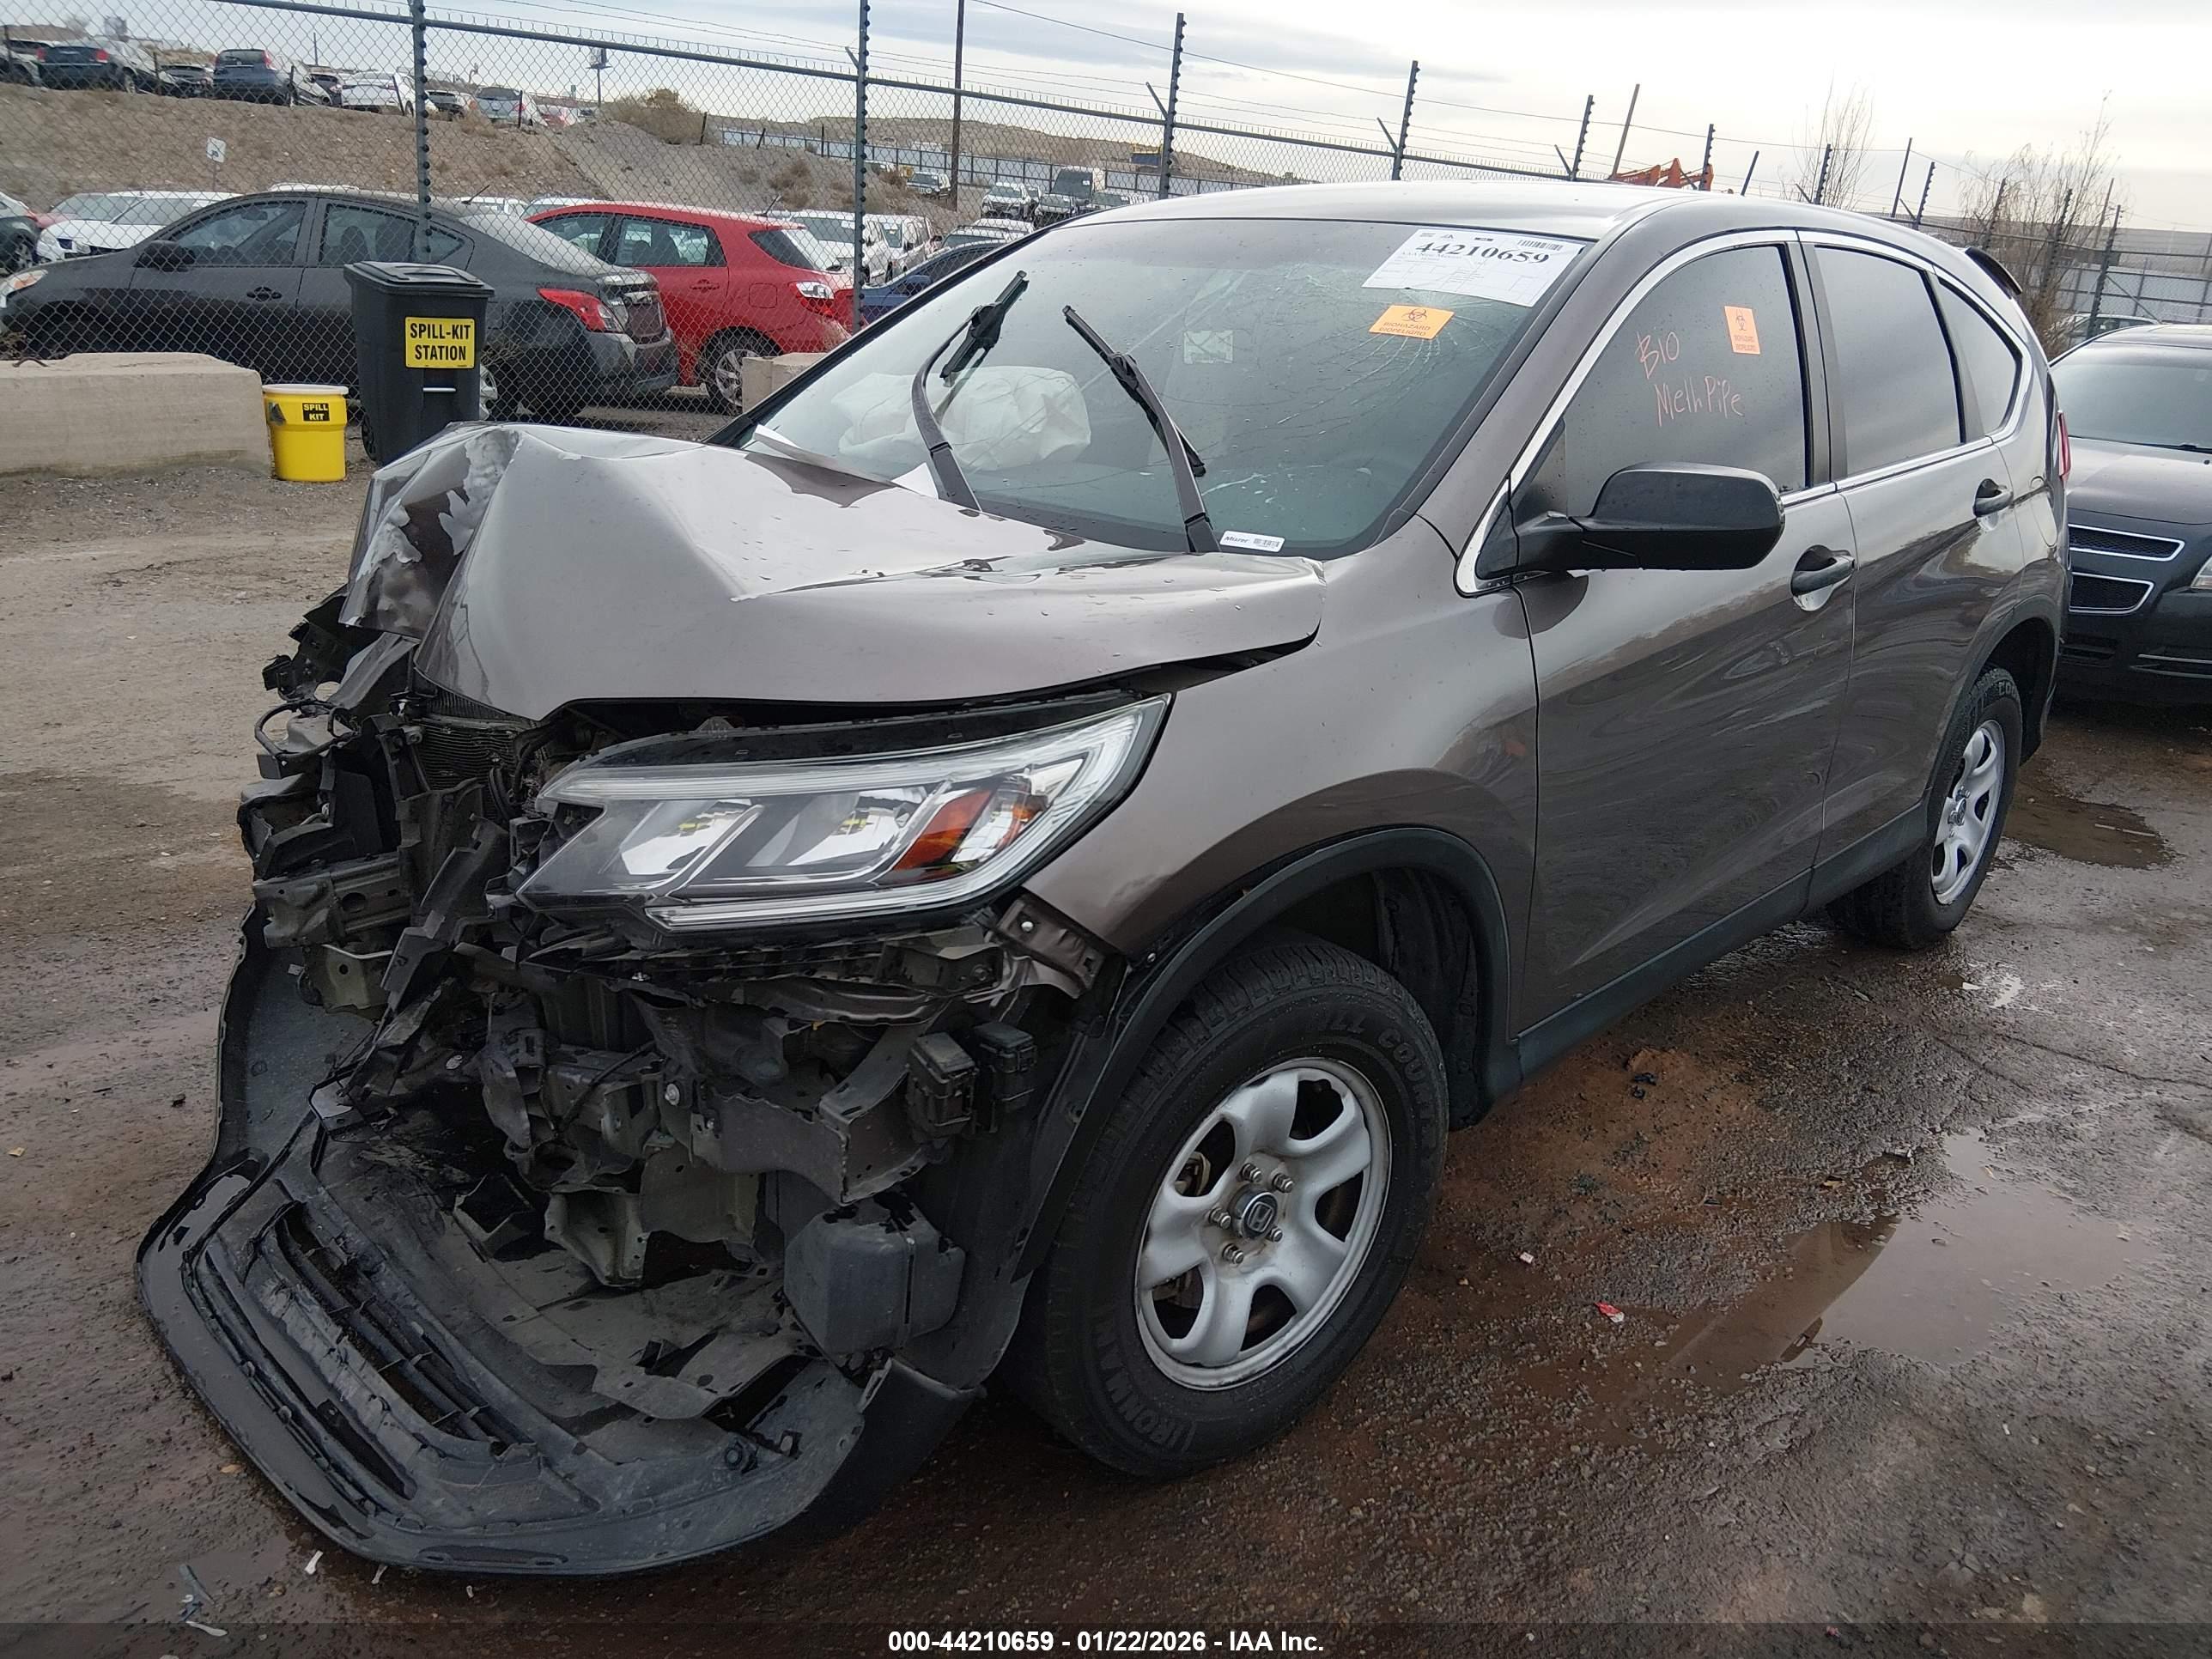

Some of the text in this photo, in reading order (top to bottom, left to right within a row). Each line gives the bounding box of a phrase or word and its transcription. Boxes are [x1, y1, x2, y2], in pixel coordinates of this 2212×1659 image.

[1415, 242, 1549, 264] 44210659
[410, 323, 471, 340] SPILL-KIT
[415, 344, 466, 361] STATION
[1635, 331, 1680, 380] BIO
